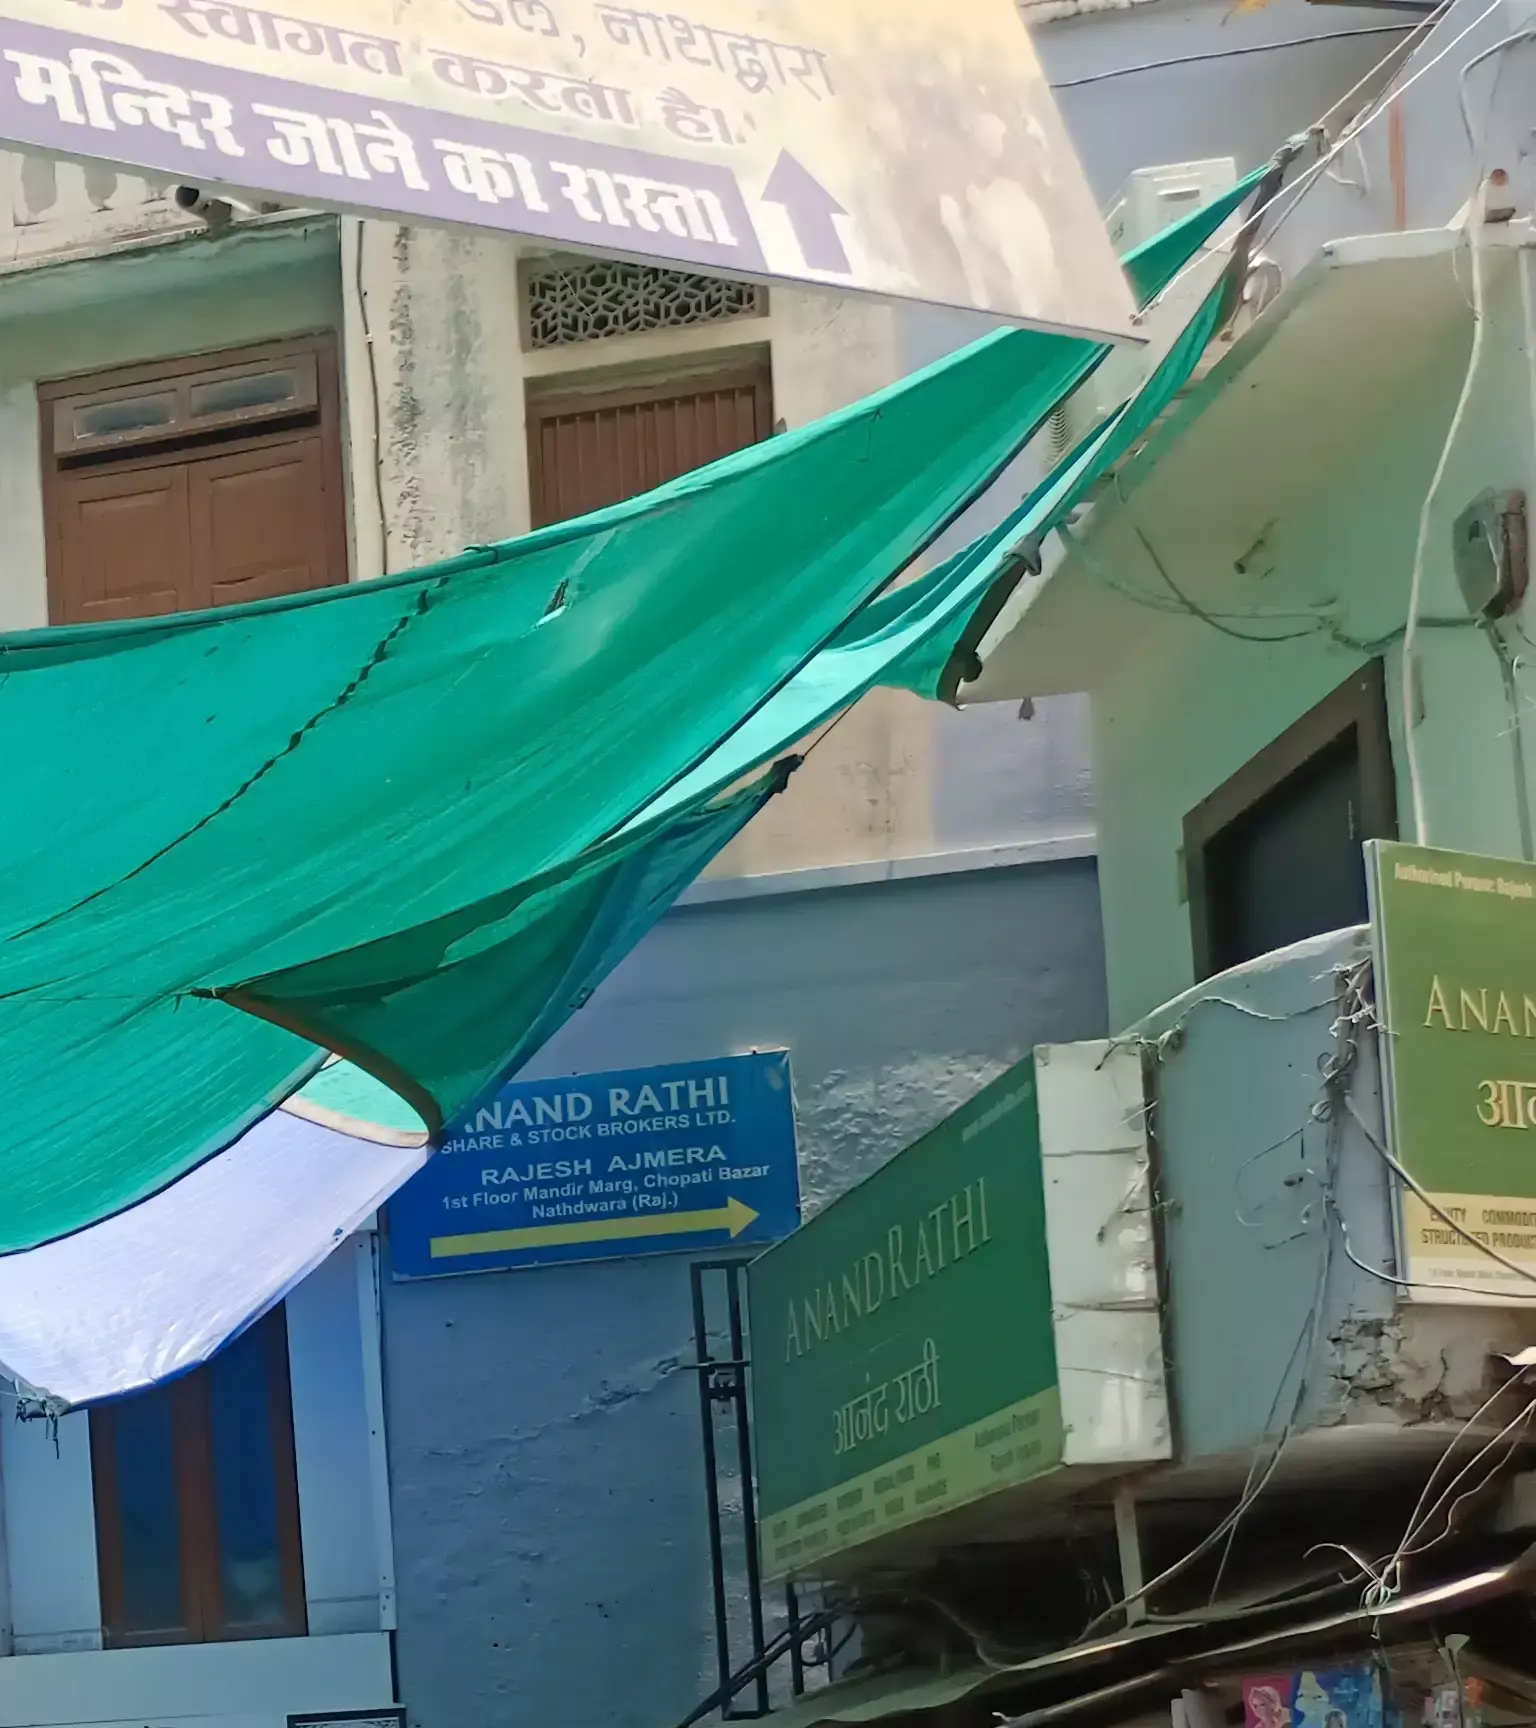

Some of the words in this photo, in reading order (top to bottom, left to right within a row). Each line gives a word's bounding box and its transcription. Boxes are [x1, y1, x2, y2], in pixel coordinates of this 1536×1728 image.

[6, 45, 253, 157] मन्दिर
[253, 102, 428, 191] जाने
[434, 138, 551, 213] का
[553, 160, 739, 247] रास्ता
[464, 1093, 593, 1133] NAND
[609, 1075, 730, 1117] RATHI
[440, 1134, 505, 1155] SHARE
[510, 1132, 523, 1147] &
[528, 1124, 592, 1145] STOCK
[597, 1113, 690, 1137] BROKERS
[695, 1110, 737, 1127] LTD.
[442, 1195, 469, 1211] 1st
[473, 1188, 518, 1207] Floor
[523, 1183, 585, 1201] Mandir
[644, 1169, 714, 1192] Chopati
[718, 1163, 771, 1181] Bazar
[481, 1158, 592, 1186] RAJESH
[607, 1144, 727, 1173] AJMERA
[532, 1197, 627, 1220] Nathdwara
[632, 1192, 679, 1213] (Raj.)
